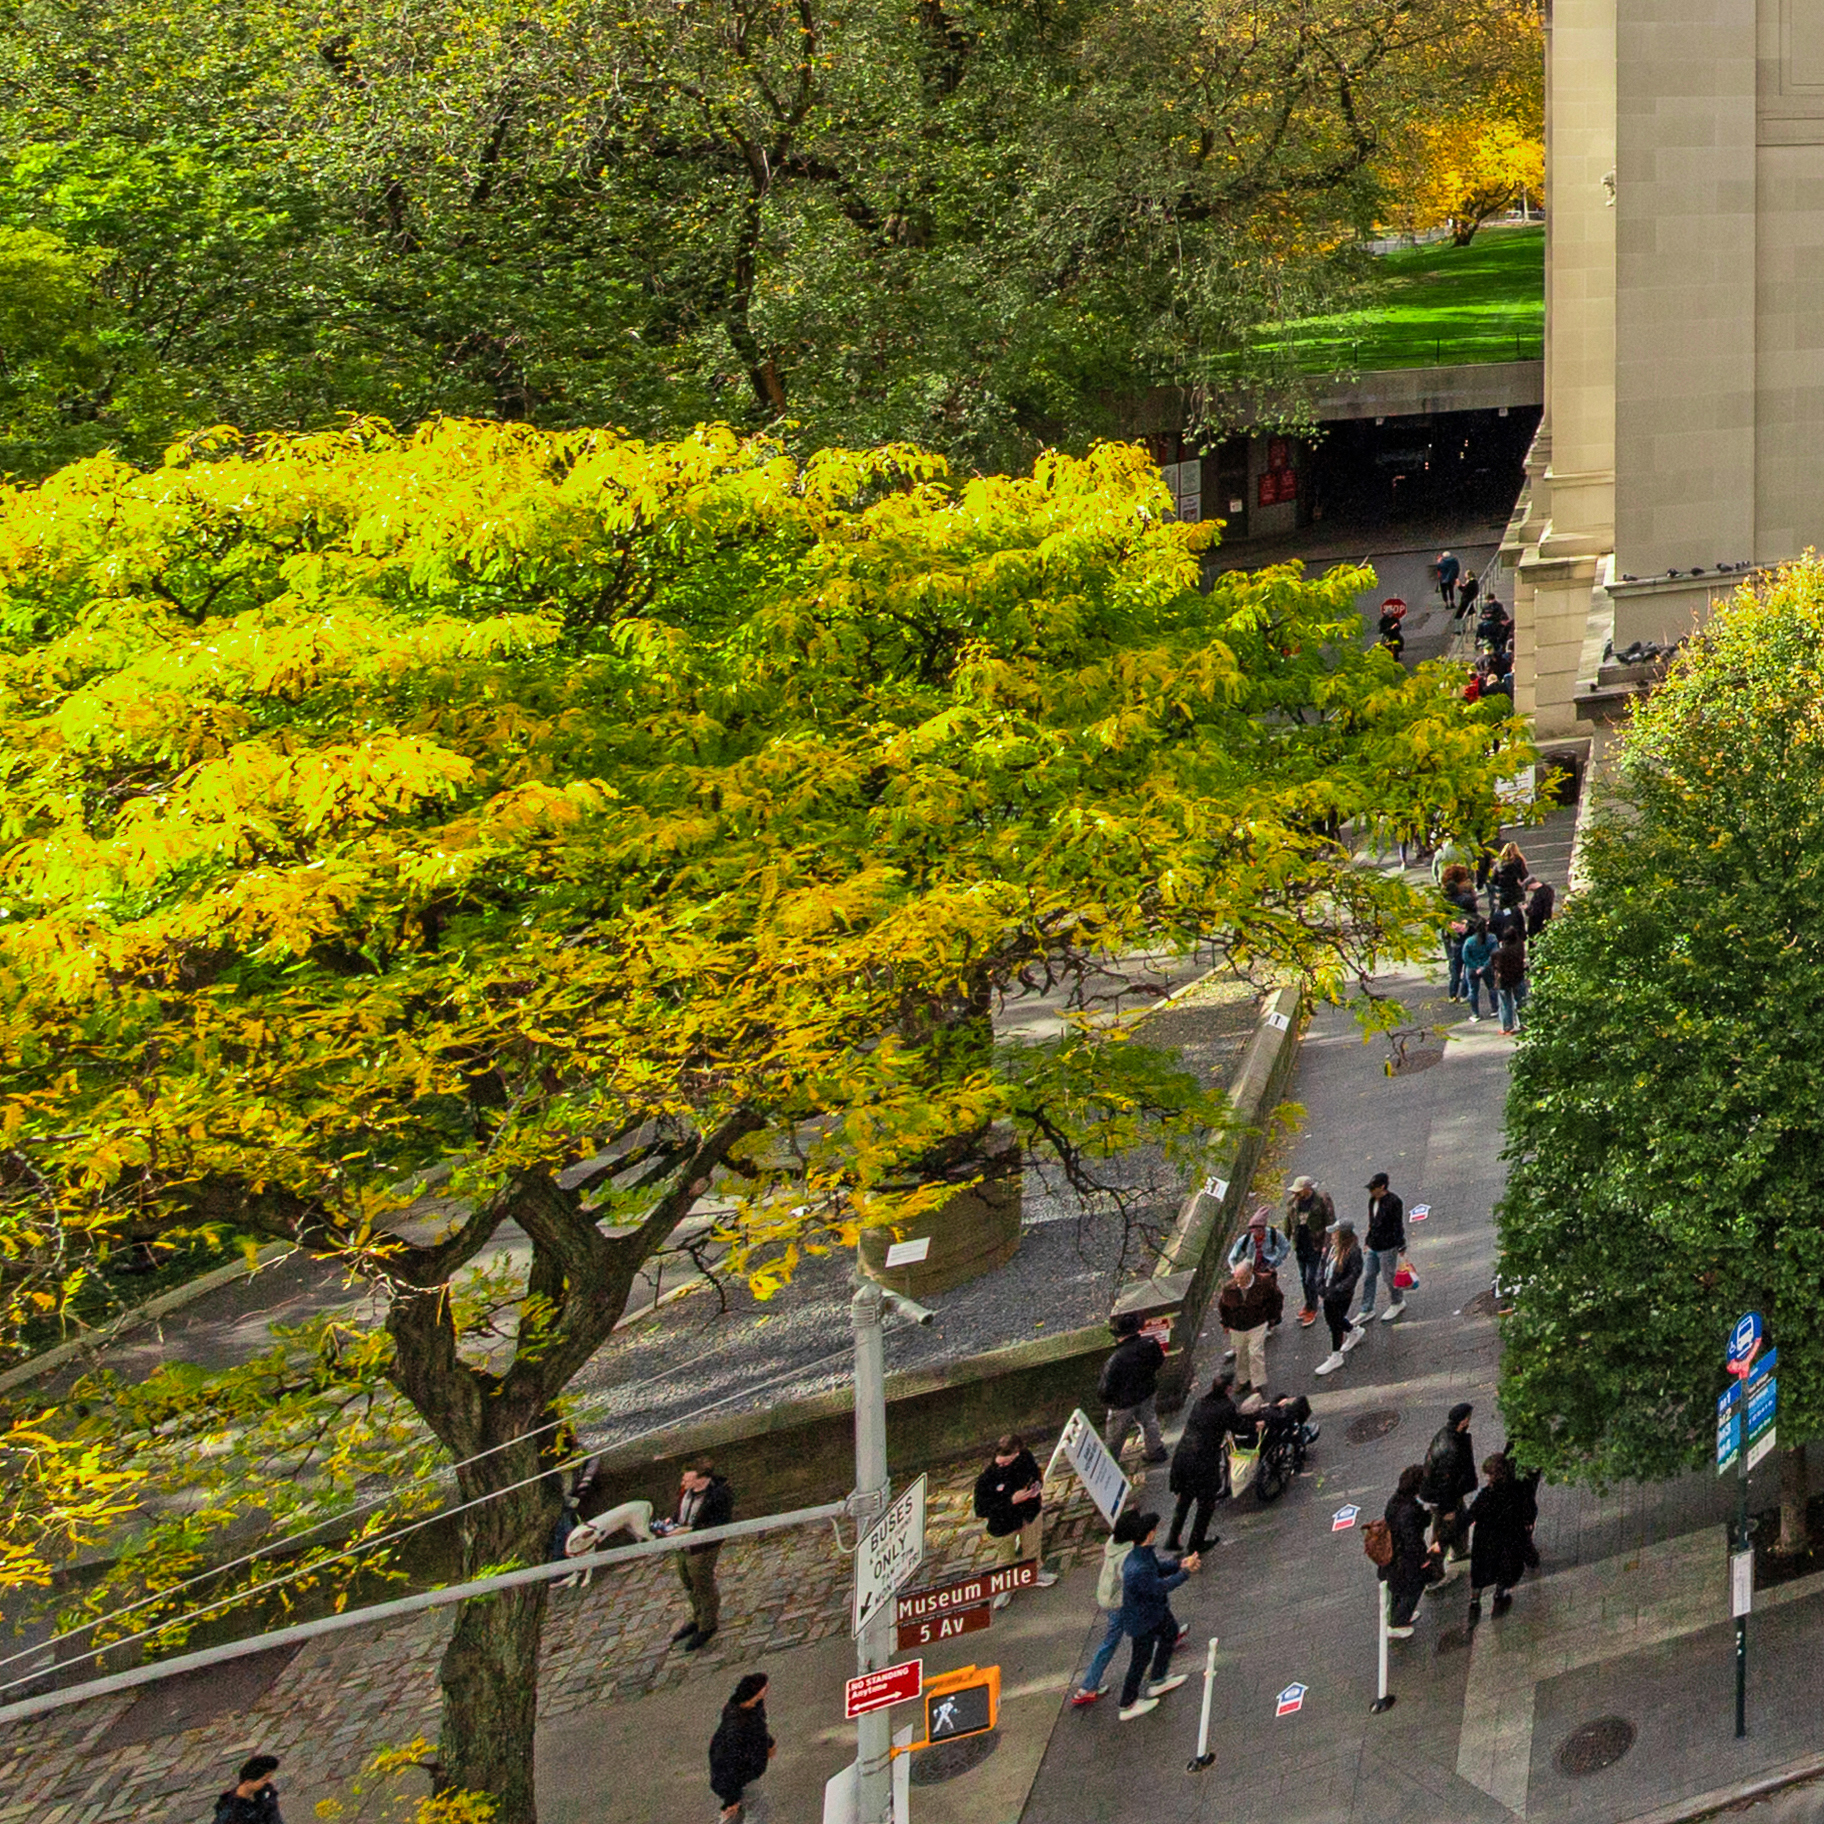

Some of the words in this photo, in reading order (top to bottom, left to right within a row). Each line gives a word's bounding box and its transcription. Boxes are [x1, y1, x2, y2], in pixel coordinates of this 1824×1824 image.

[871, 1495, 913, 1553] BUSES
[874, 1531, 907, 1580] ONLY
[899, 1582, 981, 1619] Museum
[990, 1568, 1031, 1593] Mile
[920, 1624, 930, 1643] 5
[940, 1617, 964, 1639] Av
[851, 1680, 865, 1691] NO
[865, 1666, 910, 1687] STANDING
[851, 1682, 888, 1699] Anytime
